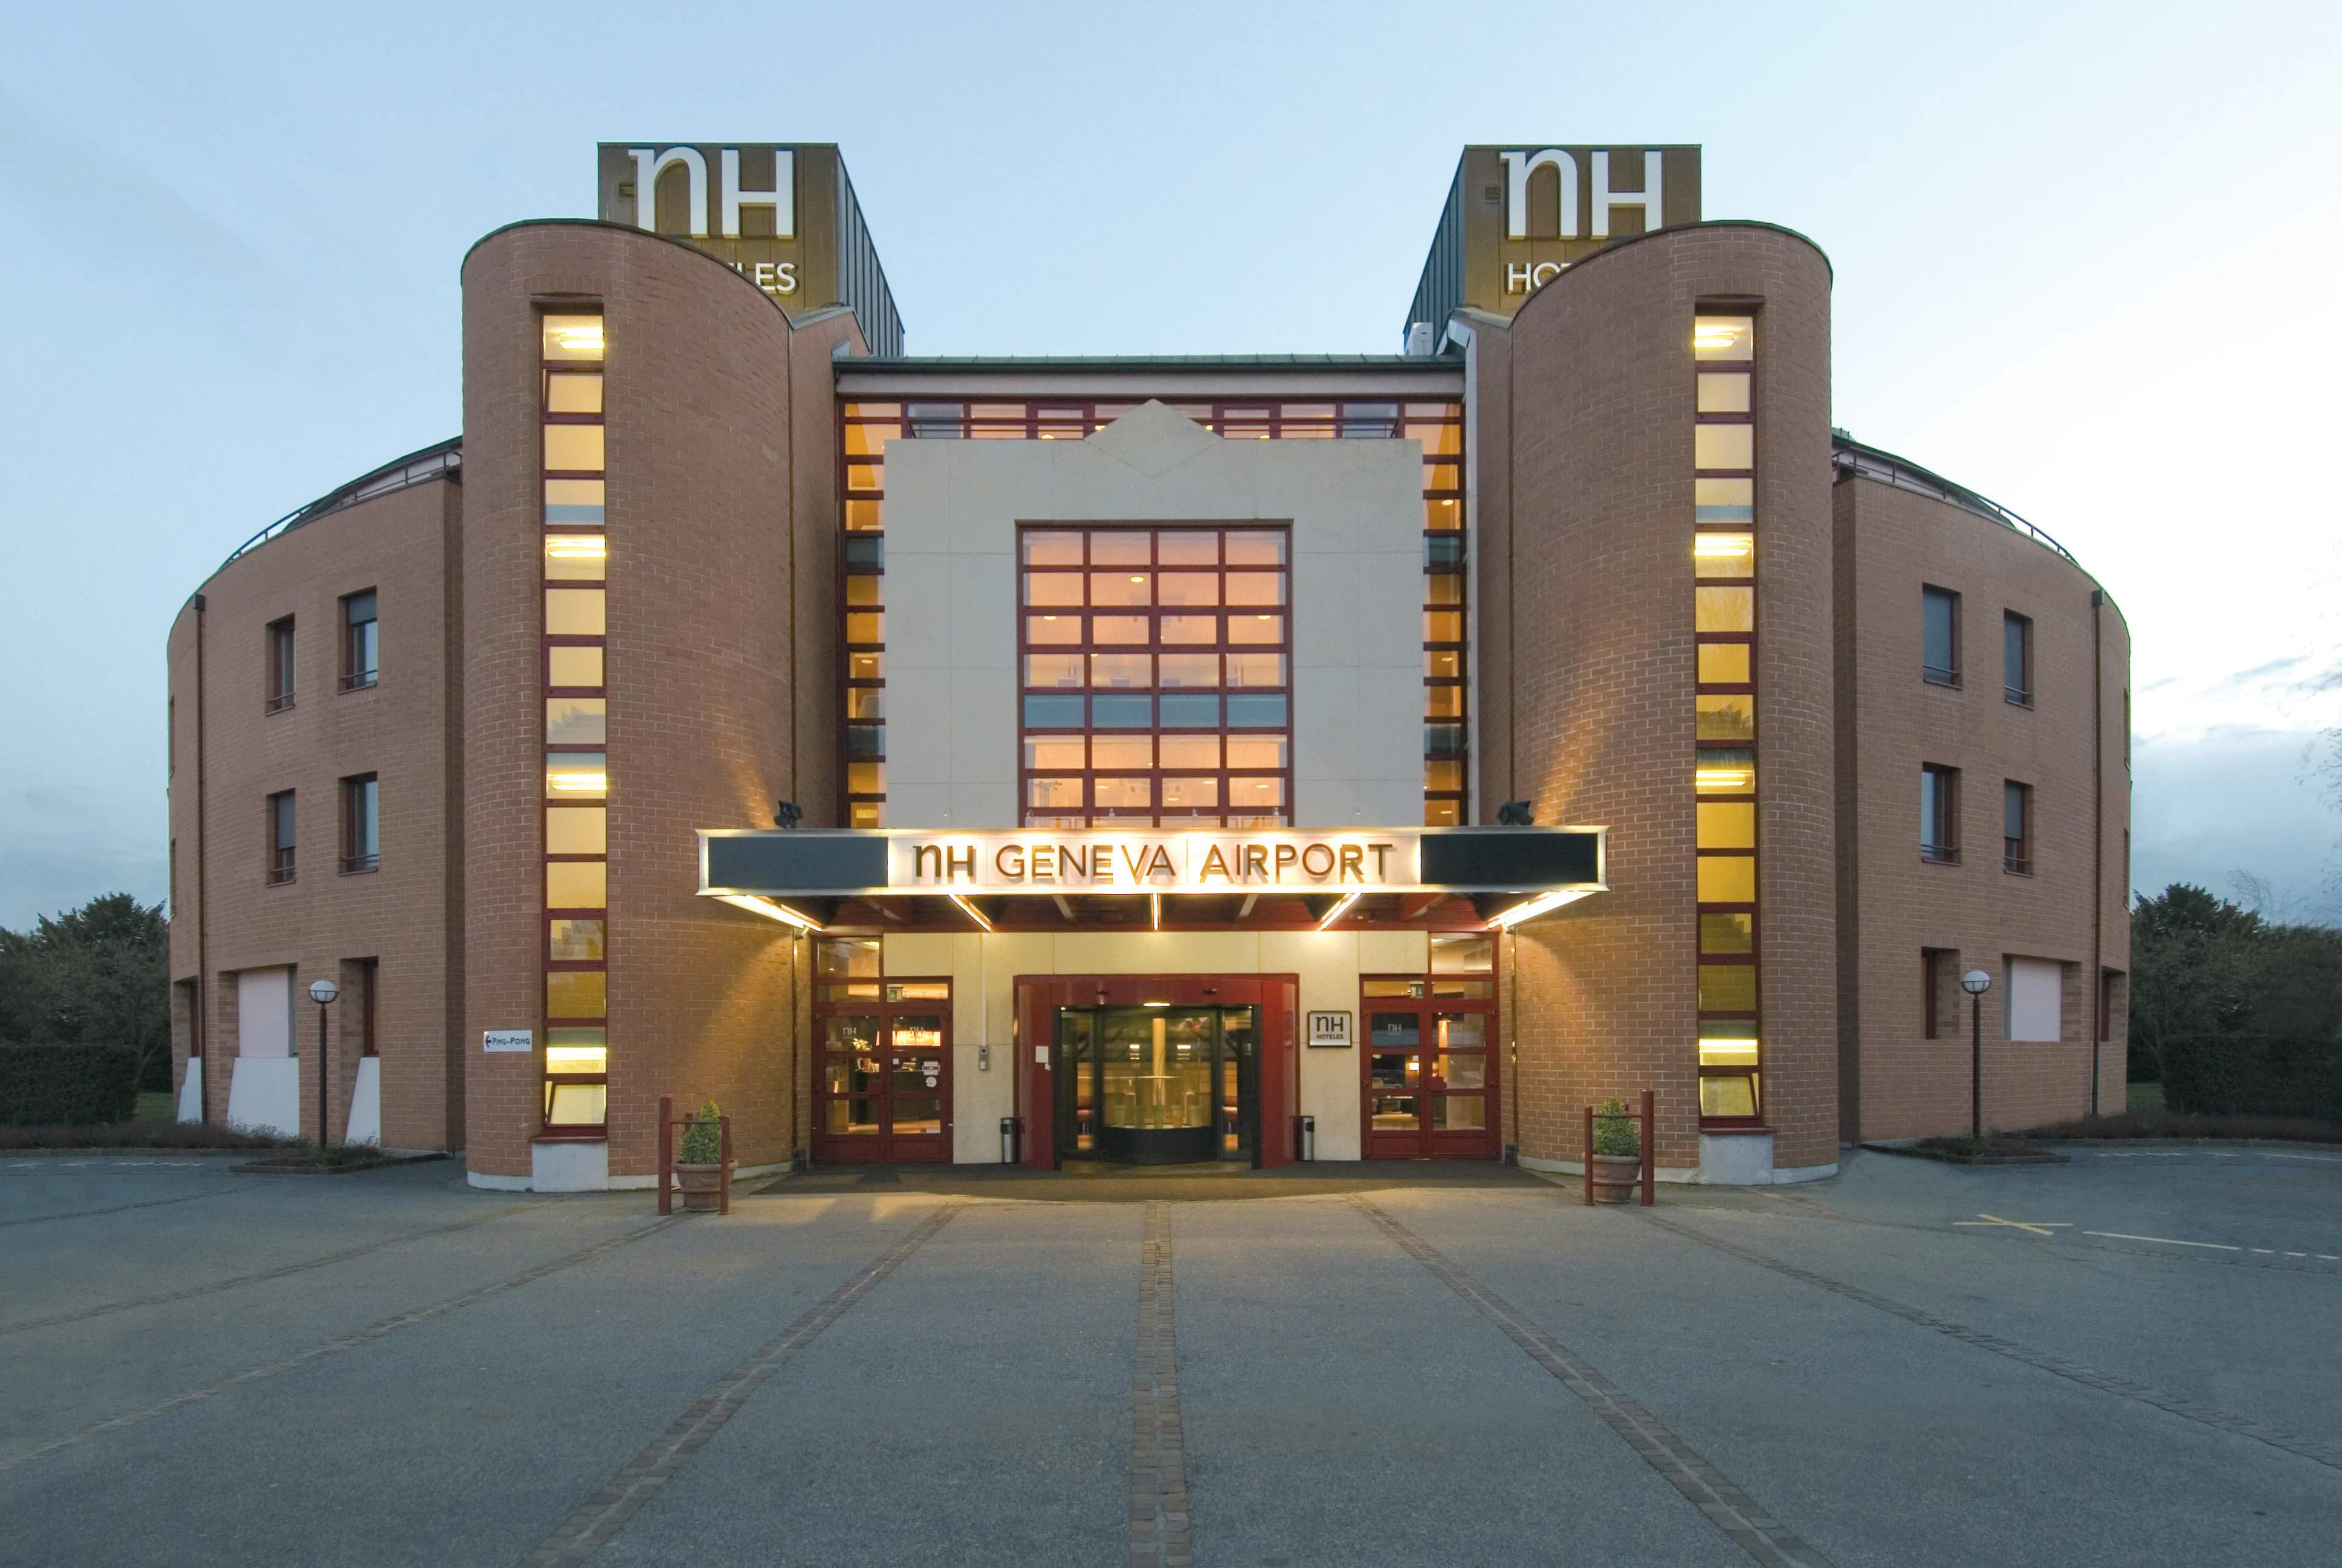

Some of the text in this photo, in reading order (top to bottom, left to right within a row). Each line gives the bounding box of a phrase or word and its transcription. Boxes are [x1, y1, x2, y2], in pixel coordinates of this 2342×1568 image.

[1508, 262, 1572, 290] HO
[995, 844, 1176, 885] GENEVA
[1200, 843, 1393, 884] AIRPORT
